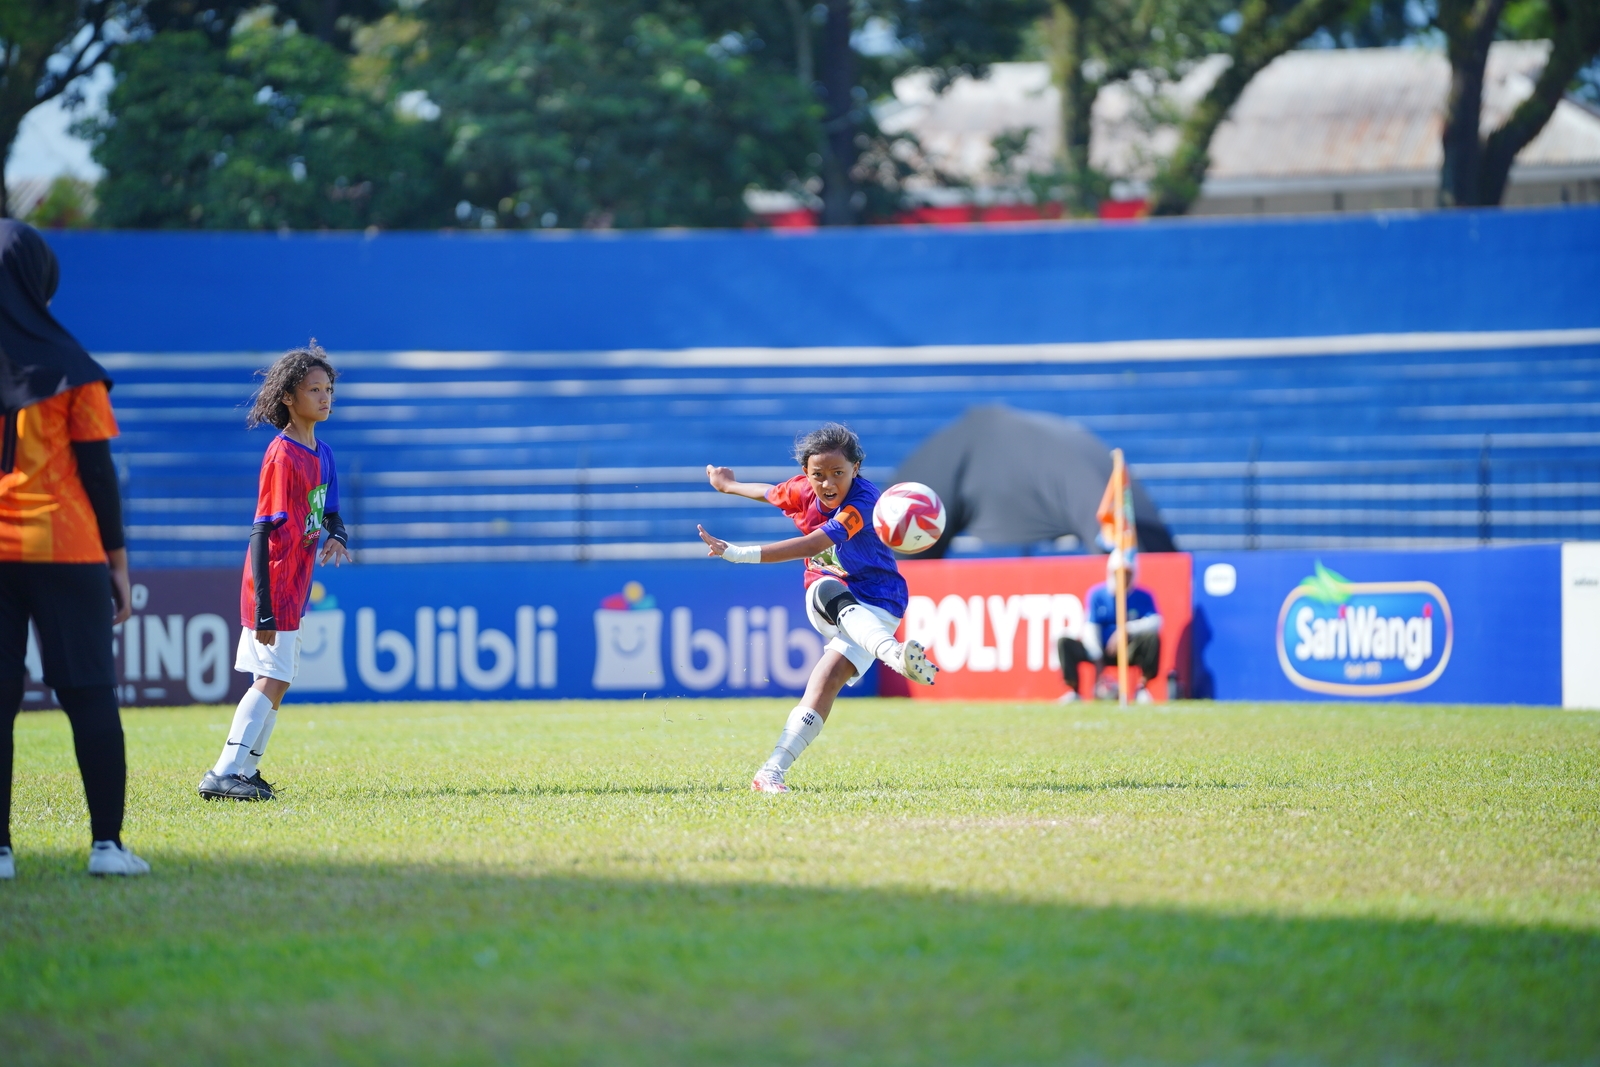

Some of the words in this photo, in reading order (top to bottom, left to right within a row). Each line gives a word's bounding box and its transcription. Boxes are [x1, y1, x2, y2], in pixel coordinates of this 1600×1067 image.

[842, 510, 861, 531] C
[356, 605, 558, 693] blibli
[670, 604, 827, 692] blib
[1294, 602, 1433, 672] SariWangi
